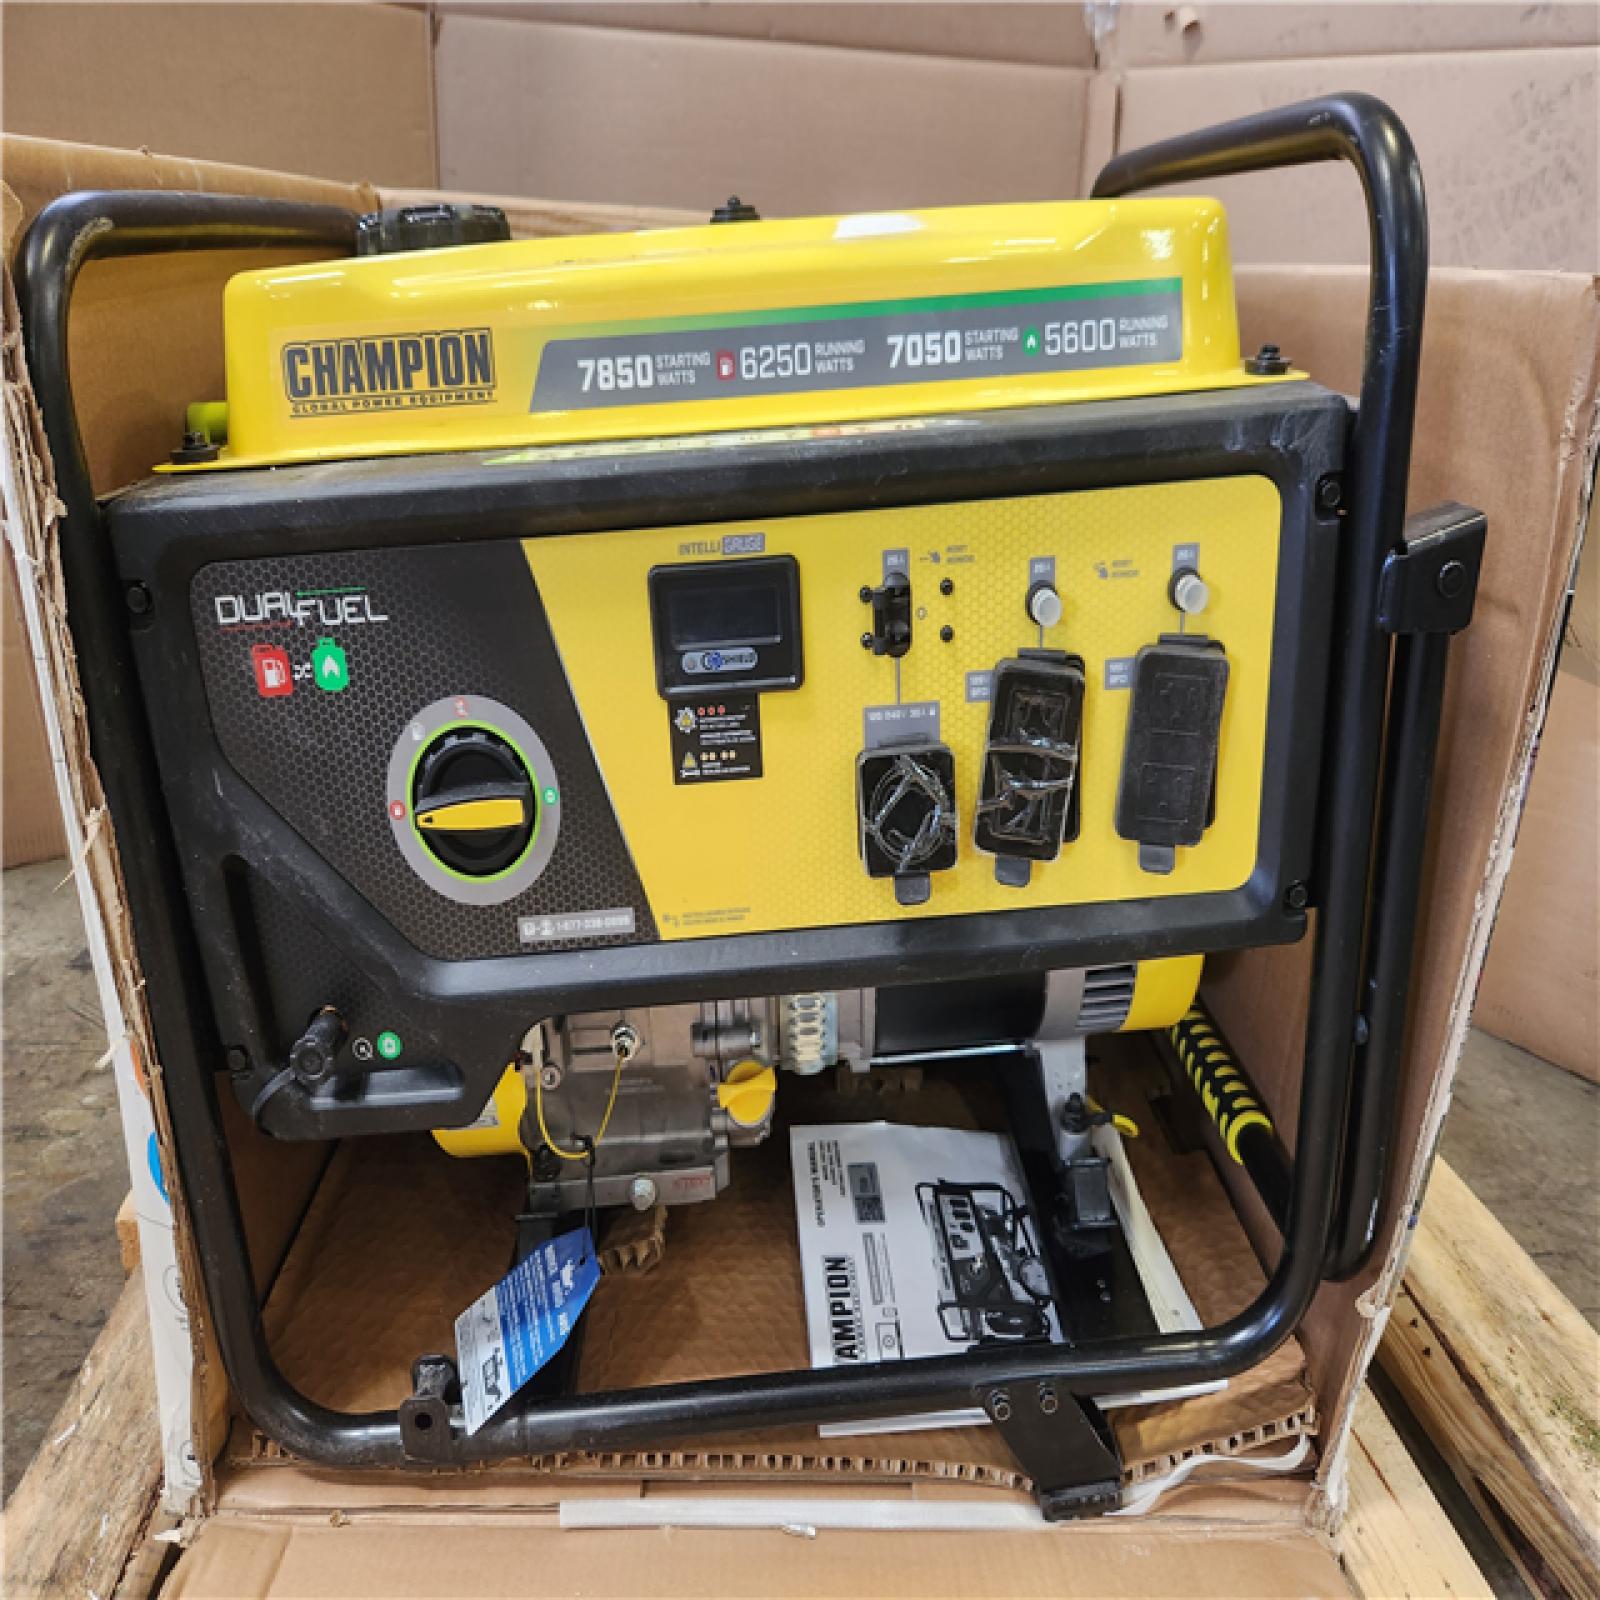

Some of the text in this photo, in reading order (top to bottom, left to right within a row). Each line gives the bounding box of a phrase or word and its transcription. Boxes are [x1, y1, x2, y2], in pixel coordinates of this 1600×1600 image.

[1119, 314, 1169, 332] RUNNING
[964, 326, 1020, 346] STARTING
[1044, 318, 1116, 356] 5600
[1119, 333, 1157, 349] WATTS
[814, 339, 866, 357] RUNNING
[886, 329, 961, 369] 7050
[964, 344, 1003, 361] WATTS
[284, 332, 493, 399] CHAMPION
[655, 351, 711, 369] STARTING
[739, 341, 811, 381] 6250
[814, 357, 854, 374] WATTS
[576, 354, 654, 393] 7850
[656, 369, 696, 386] WATTS
[824, 1256, 859, 1361] AMPION
